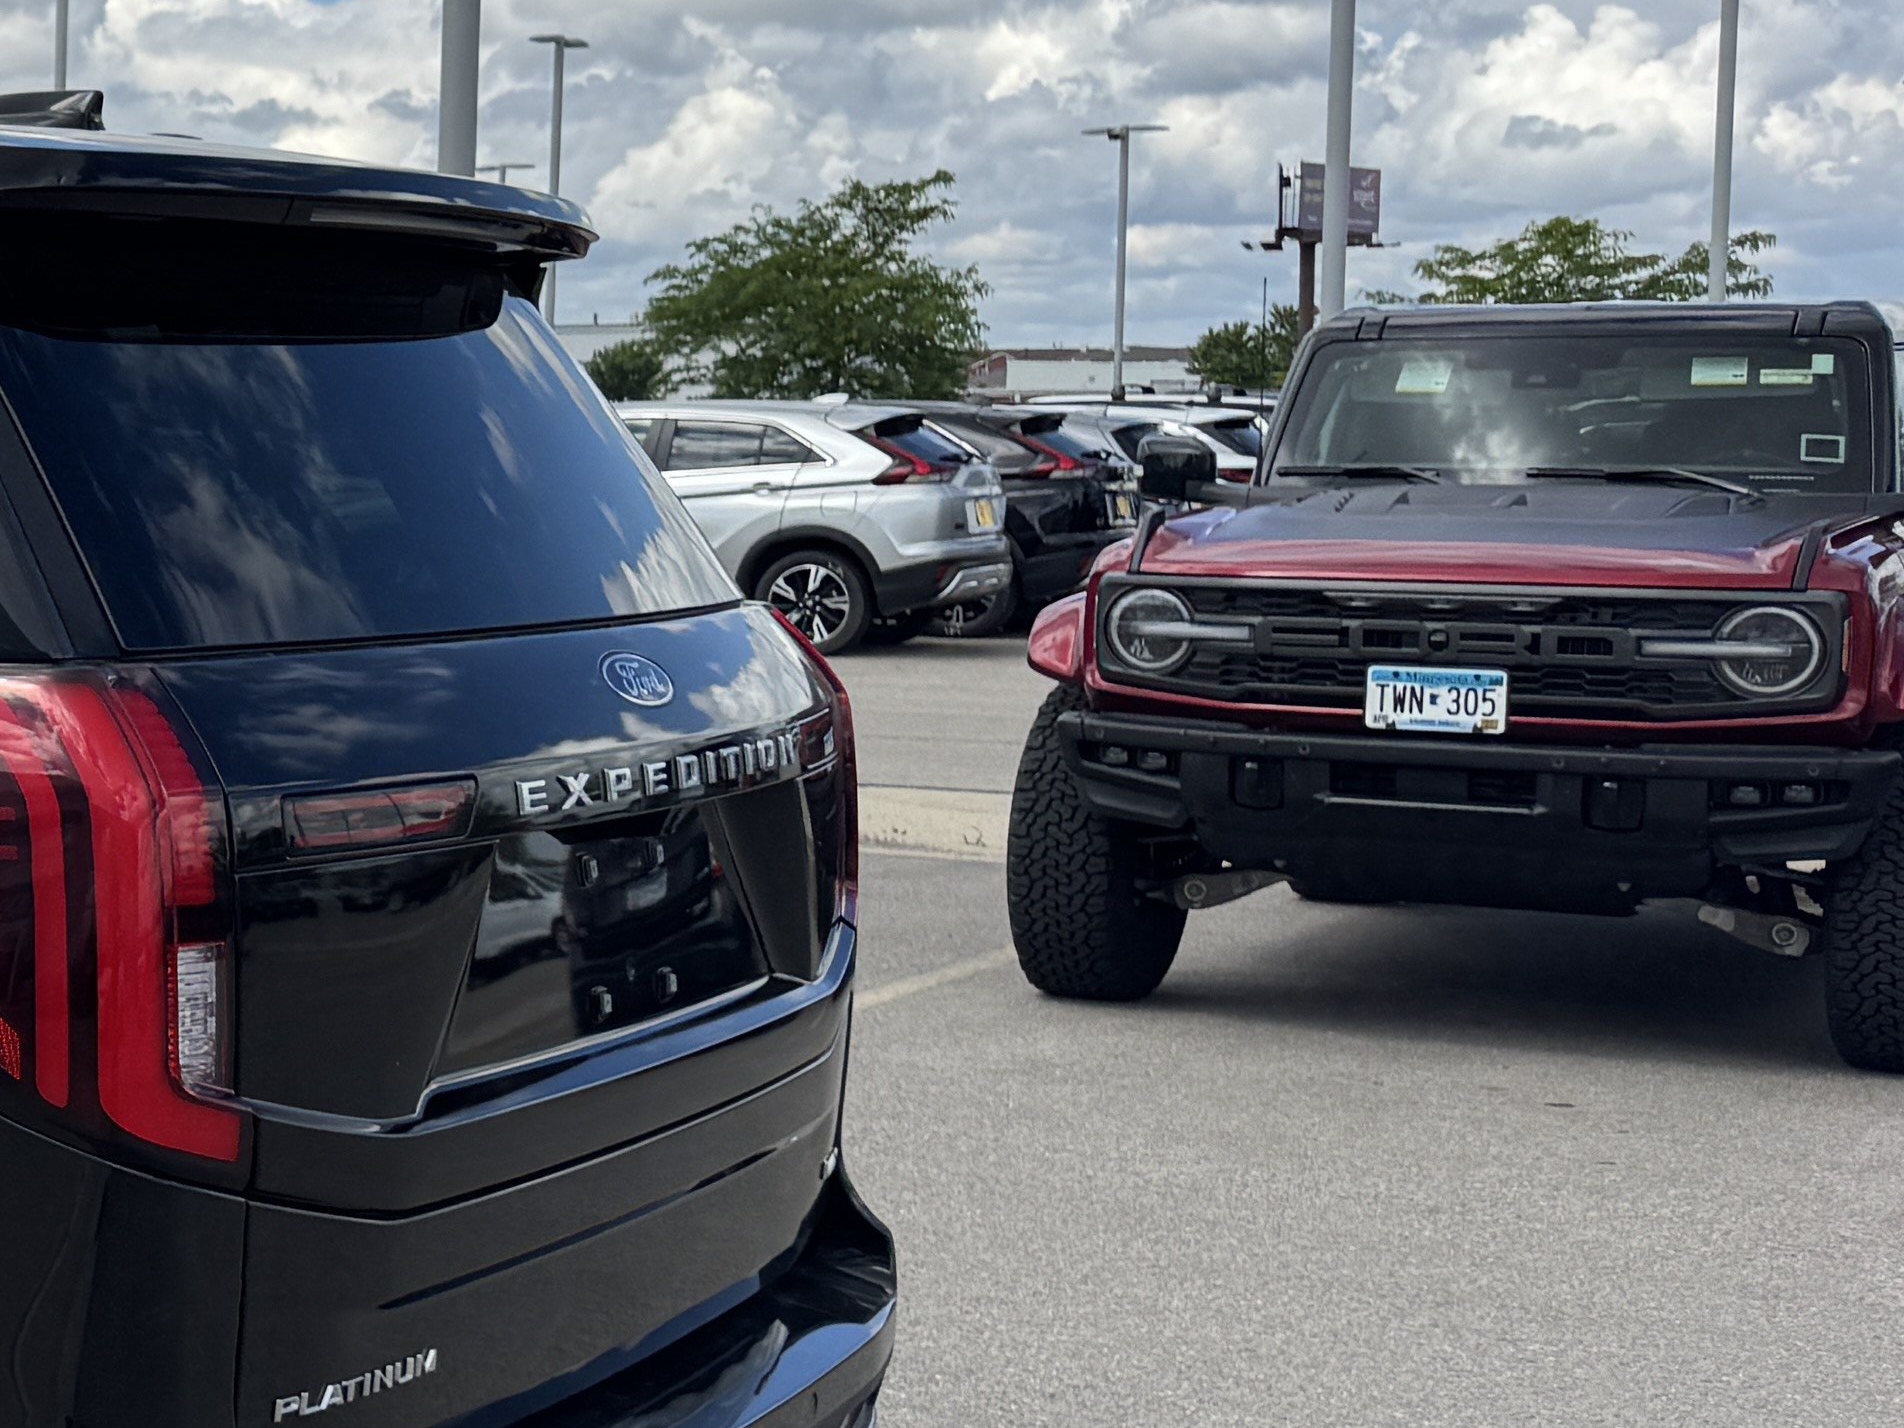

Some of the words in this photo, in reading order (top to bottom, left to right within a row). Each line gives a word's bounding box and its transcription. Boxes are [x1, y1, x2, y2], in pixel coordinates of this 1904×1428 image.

[614, 660, 667, 699] Ford
[1375, 683, 1424, 715] TWN
[1446, 685, 1497, 717] 305
[515, 725, 802, 816] EXPEDITION
[273, 1347, 438, 1423] PLATINUM
